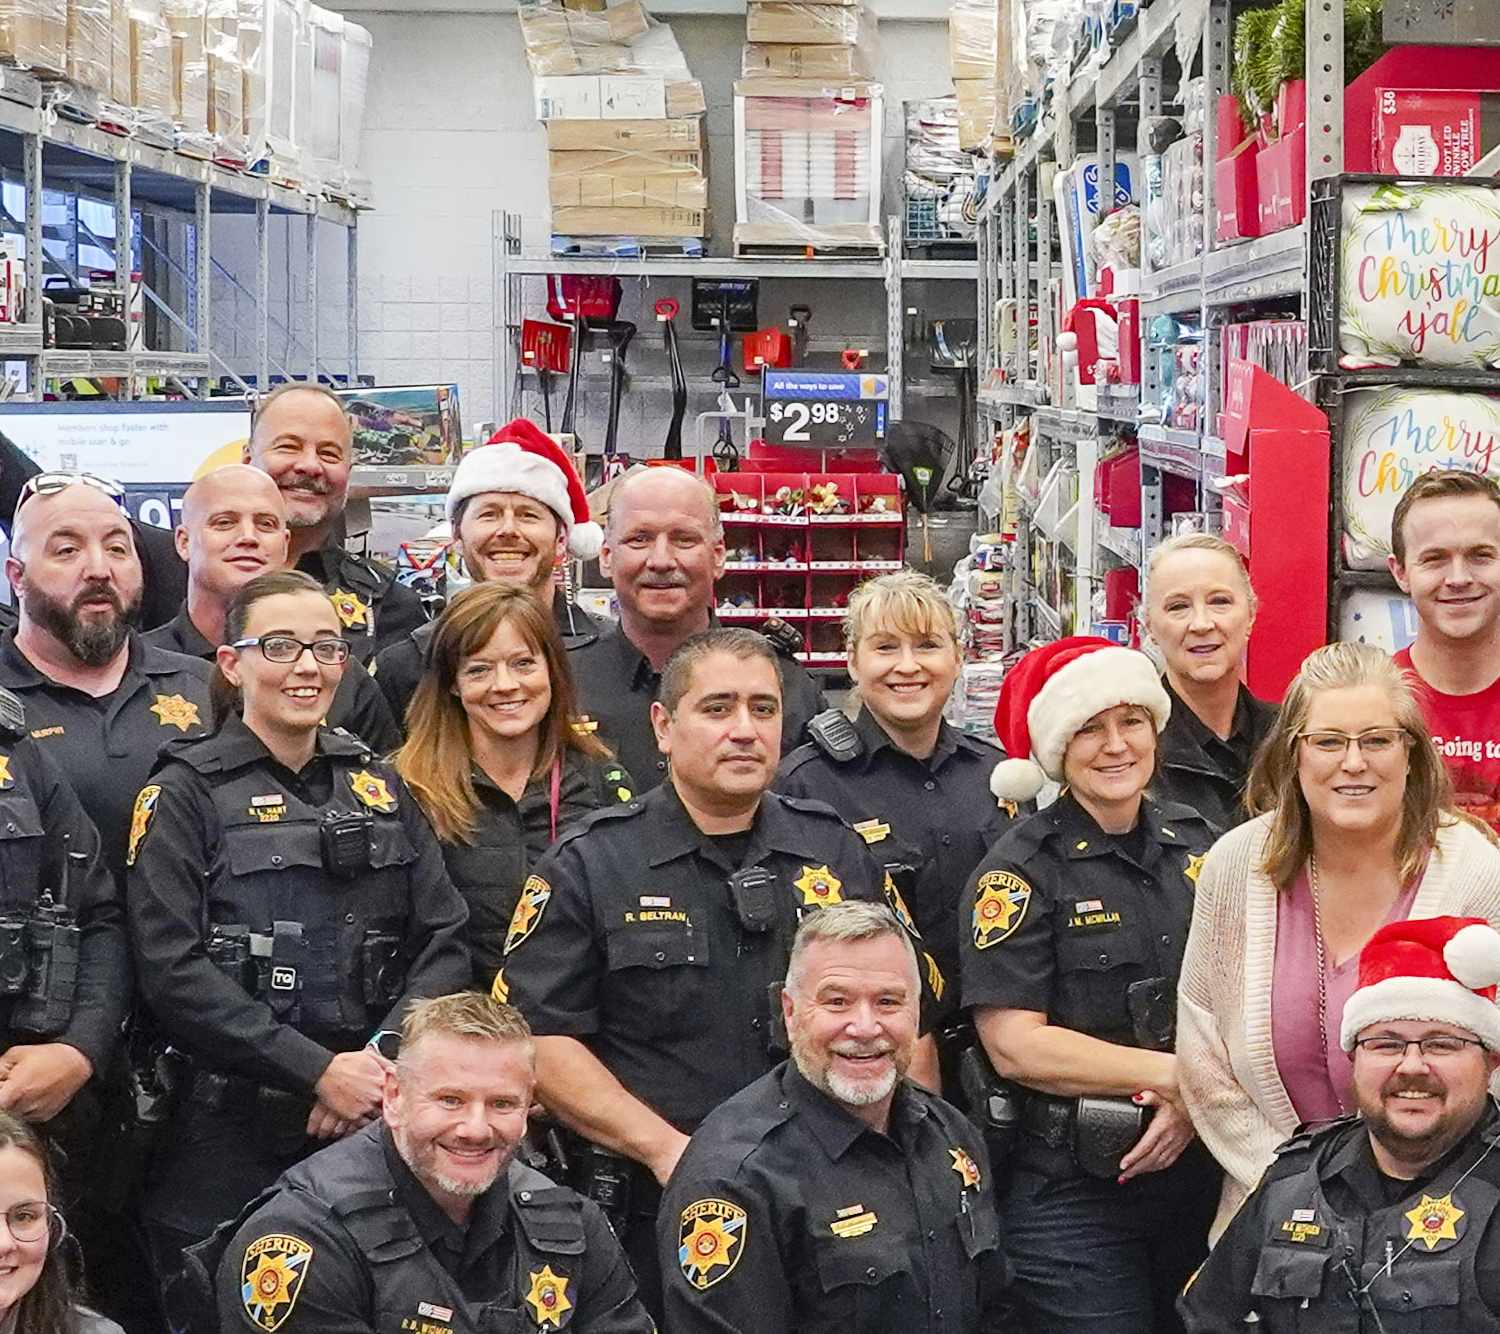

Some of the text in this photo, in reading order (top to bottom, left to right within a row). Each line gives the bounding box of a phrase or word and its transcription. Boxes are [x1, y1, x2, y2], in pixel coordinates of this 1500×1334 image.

[1382, 90, 1397, 116] $38
[1443, 125, 1452, 145] LED
[1460, 119, 1469, 147] TREE
[1396, 297, 1493, 354] y'all
[773, 381, 785, 390] All
[786, 381, 799, 390] the
[800, 382, 817, 392] ways
[57, 421, 170, 436] Members shop faster with
[56, 436, 85, 447] mobile
[87, 438, 108, 447] scan
[681, 1205, 748, 1226] SHERIFF
[246, 1239, 314, 1258] SHERIFF
